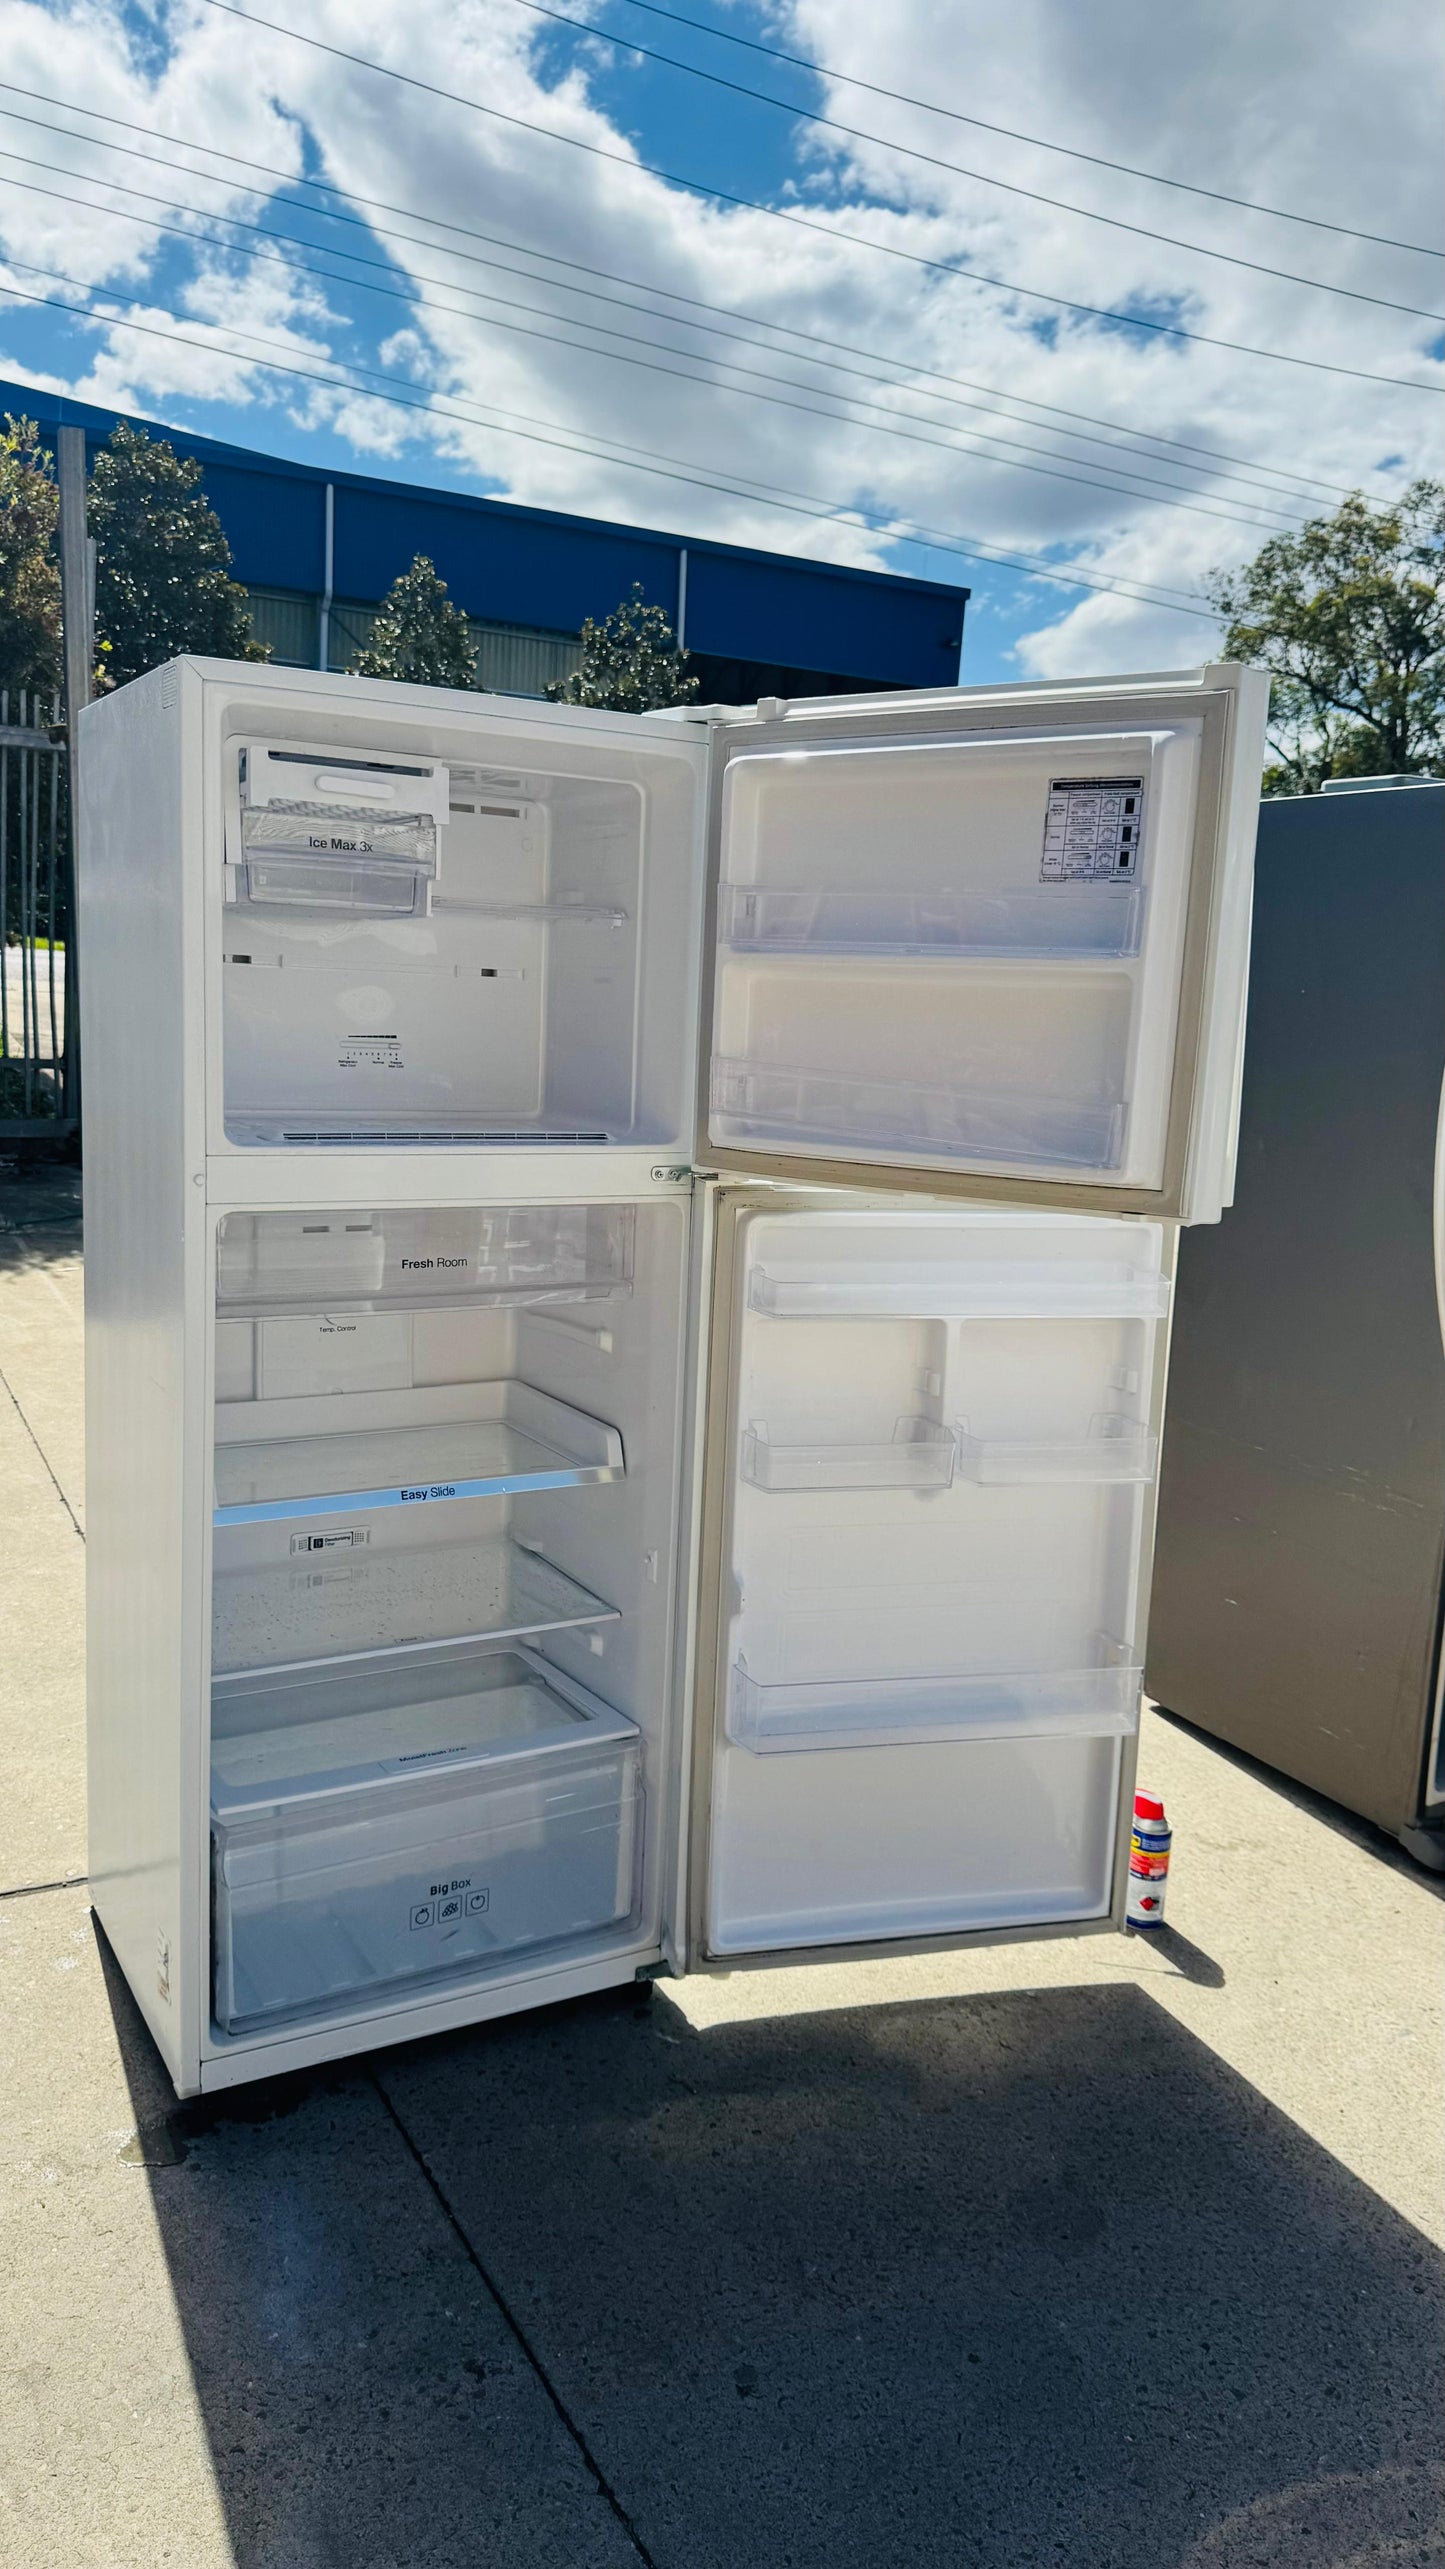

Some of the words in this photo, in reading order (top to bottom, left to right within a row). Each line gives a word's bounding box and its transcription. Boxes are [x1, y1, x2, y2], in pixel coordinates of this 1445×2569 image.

[309, 836, 328, 848] Ice
[331, 838, 357, 851] Max
[360, 841, 373, 852] 3x
[401, 1259, 434, 1269] Fresh
[437, 1257, 468, 1268] Room
[400, 1490, 428, 1501] Easy
[430, 1486, 456, 1498] Slide
[430, 1884, 449, 1896] Big
[451, 1879, 471, 1891] Box
